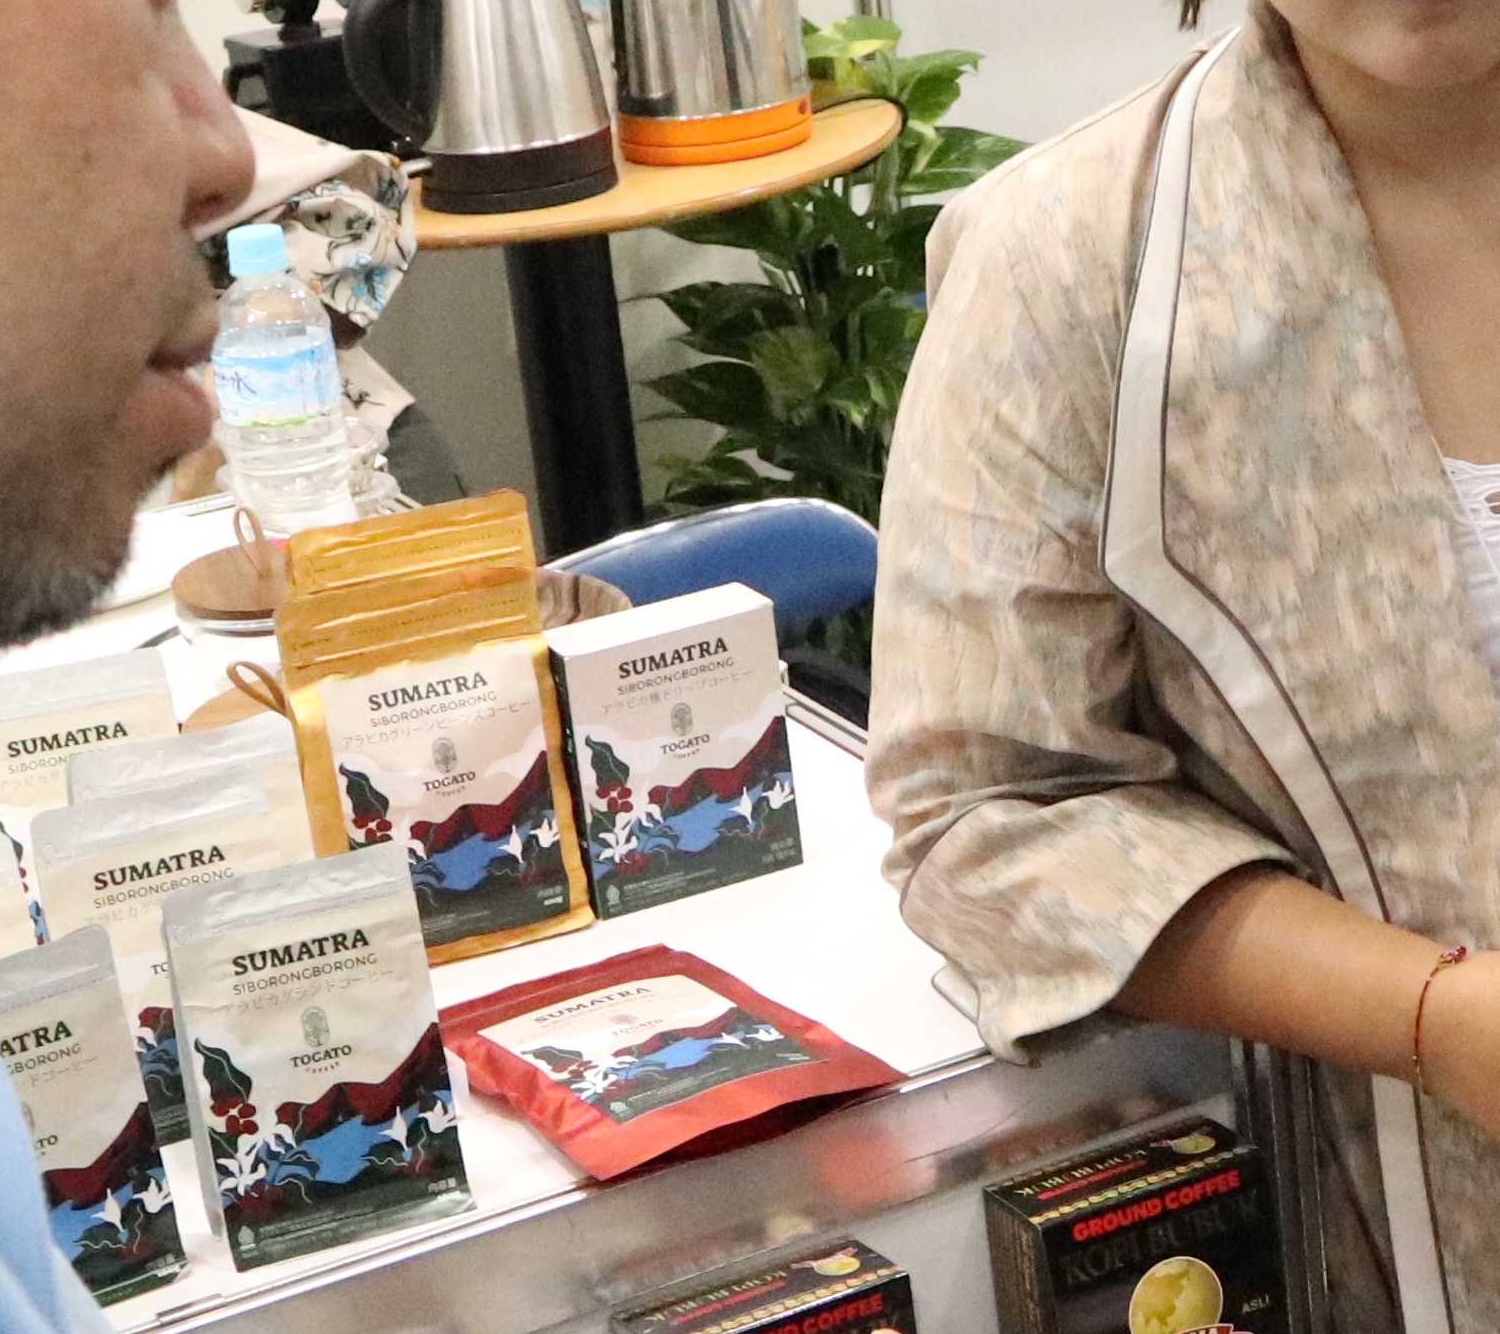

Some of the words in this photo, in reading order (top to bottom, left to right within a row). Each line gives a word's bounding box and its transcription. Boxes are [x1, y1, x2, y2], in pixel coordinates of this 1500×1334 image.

[617, 657, 735, 696] SIBORONGBORONG
[618, 637, 729, 679] SUMATRA
[368, 671, 488, 711] SUMATRA
[370, 691, 497, 727] SIBORONGBORONG
[7, 721, 129, 758] SUMATRA
[661, 734, 710, 754] TOGATO
[8, 756, 68, 775] SIBORON
[423, 771, 476, 791] TOGATO
[93, 845, 226, 891] SUMATRA
[94, 867, 234, 908] SIBORONGBORONG
[233, 929, 369, 976] SUMATRA
[233, 953, 378, 995] SIBORONGBORONG
[534, 986, 652, 1025] SUMATRA
[0, 1020, 73, 1058] ATRA
[291, 1044, 353, 1068] TOGATO
[7, 1043, 82, 1075] GBORONG
[1071, 1197, 1163, 1242] GROUND
[1164, 1168, 1242, 1210] COFFEE
[1241, 1294, 1271, 1314] ASLI
